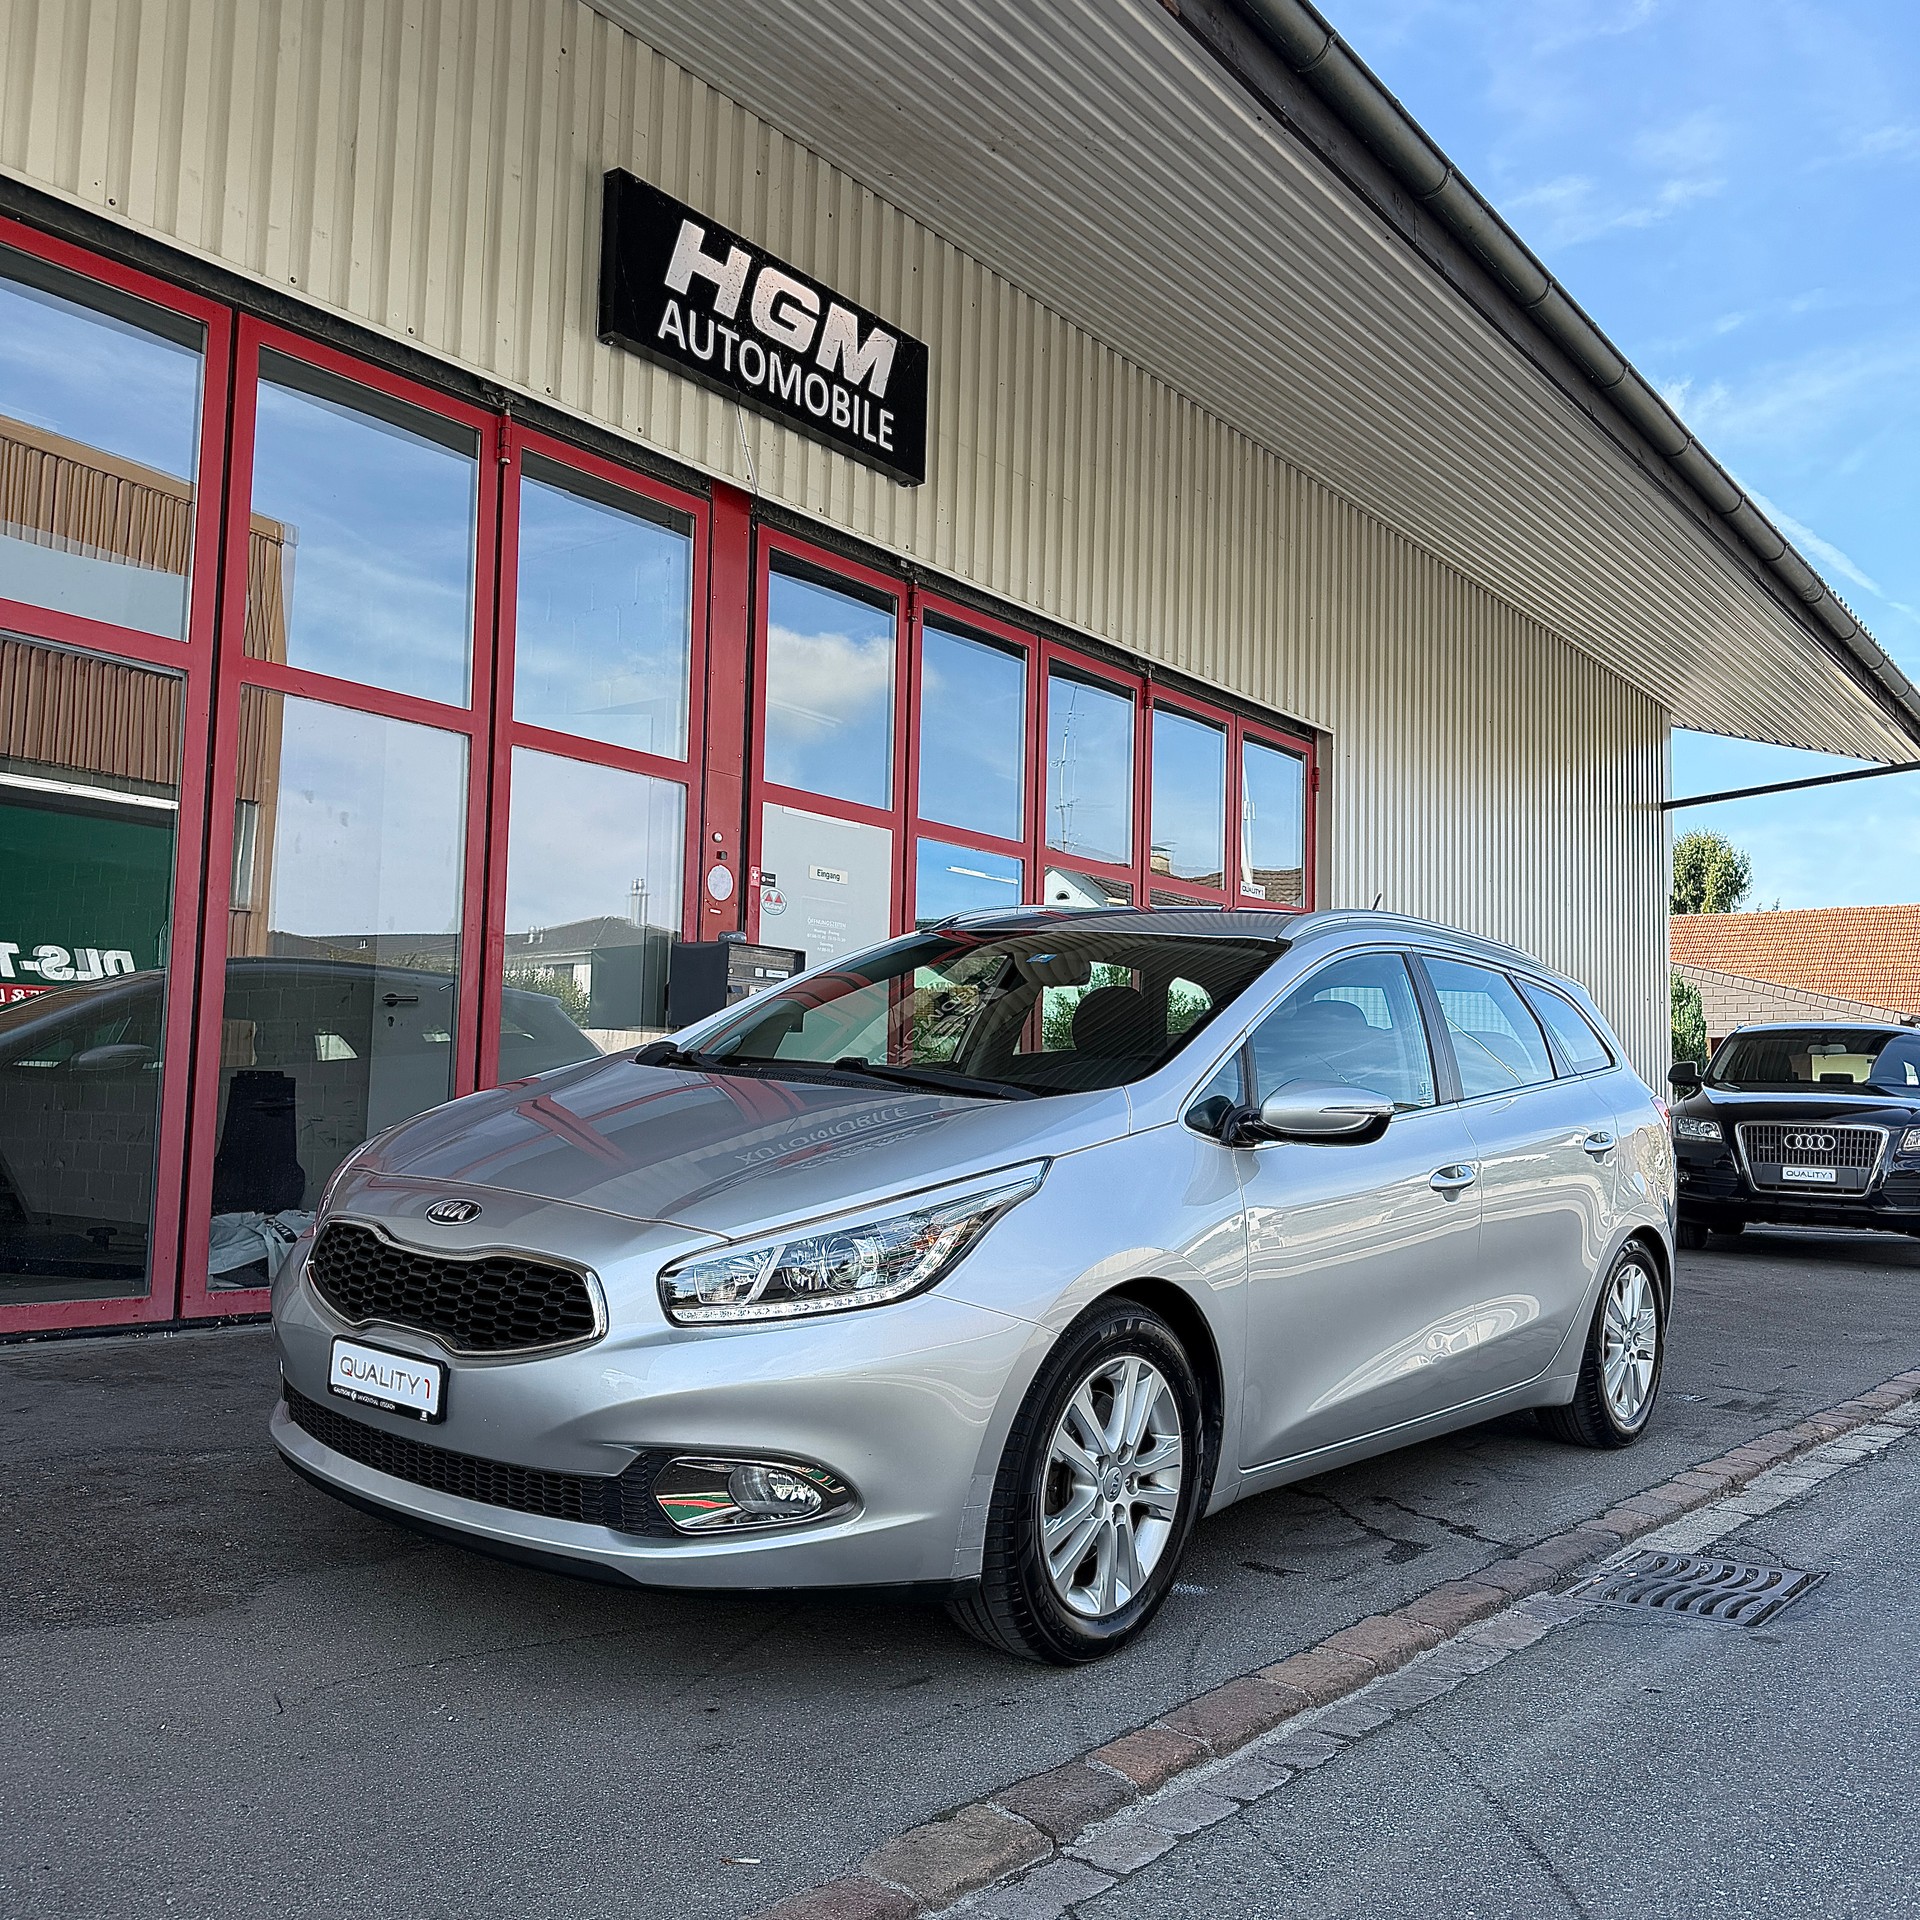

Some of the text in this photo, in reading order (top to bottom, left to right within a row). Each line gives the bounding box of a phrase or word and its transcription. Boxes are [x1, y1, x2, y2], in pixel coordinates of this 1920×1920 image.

[664, 219, 898, 399] HGM
[657, 299, 894, 452] AUTOMOBILE
[817, 869, 840, 881] Eingang
[431, 1201, 472, 1220] KIA
